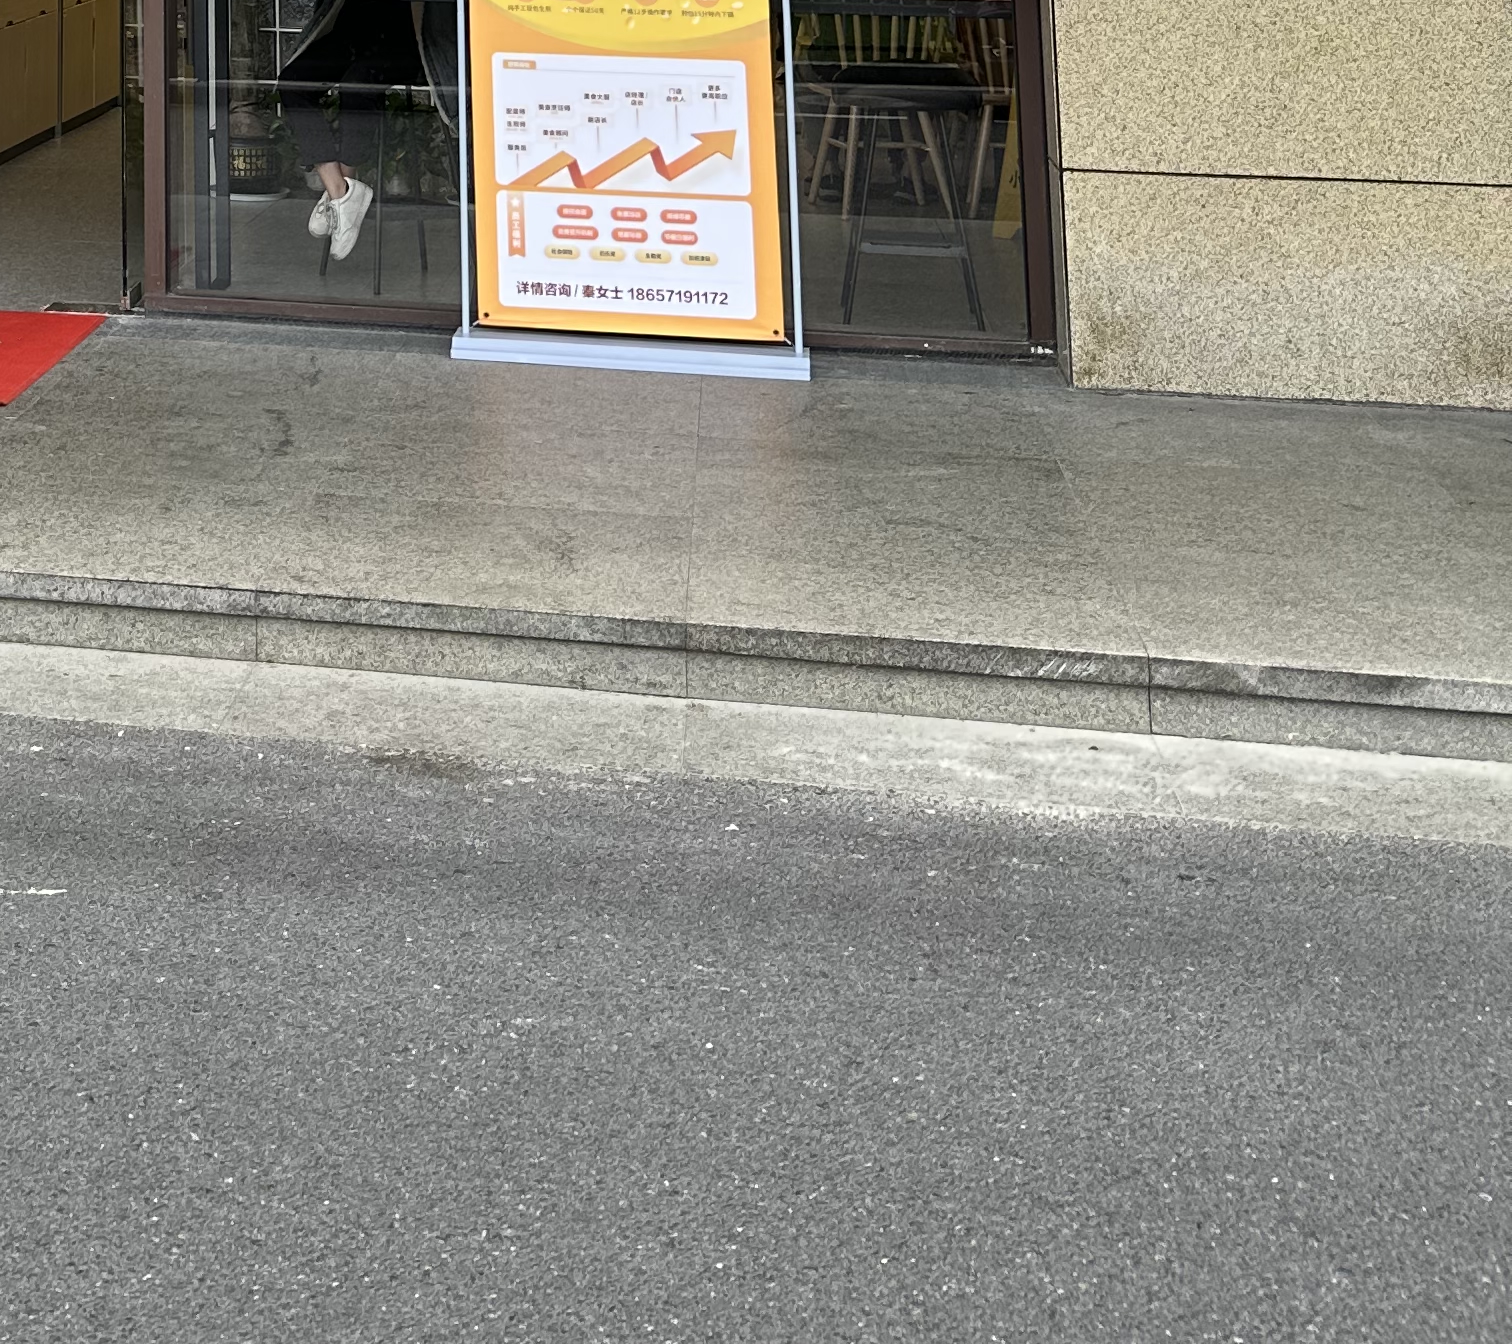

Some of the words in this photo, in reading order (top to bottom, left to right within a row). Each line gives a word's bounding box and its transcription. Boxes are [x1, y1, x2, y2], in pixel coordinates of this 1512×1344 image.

[516, 280, 571, 298] 详情咨询
[627, 287, 729, 305] 18657191172
